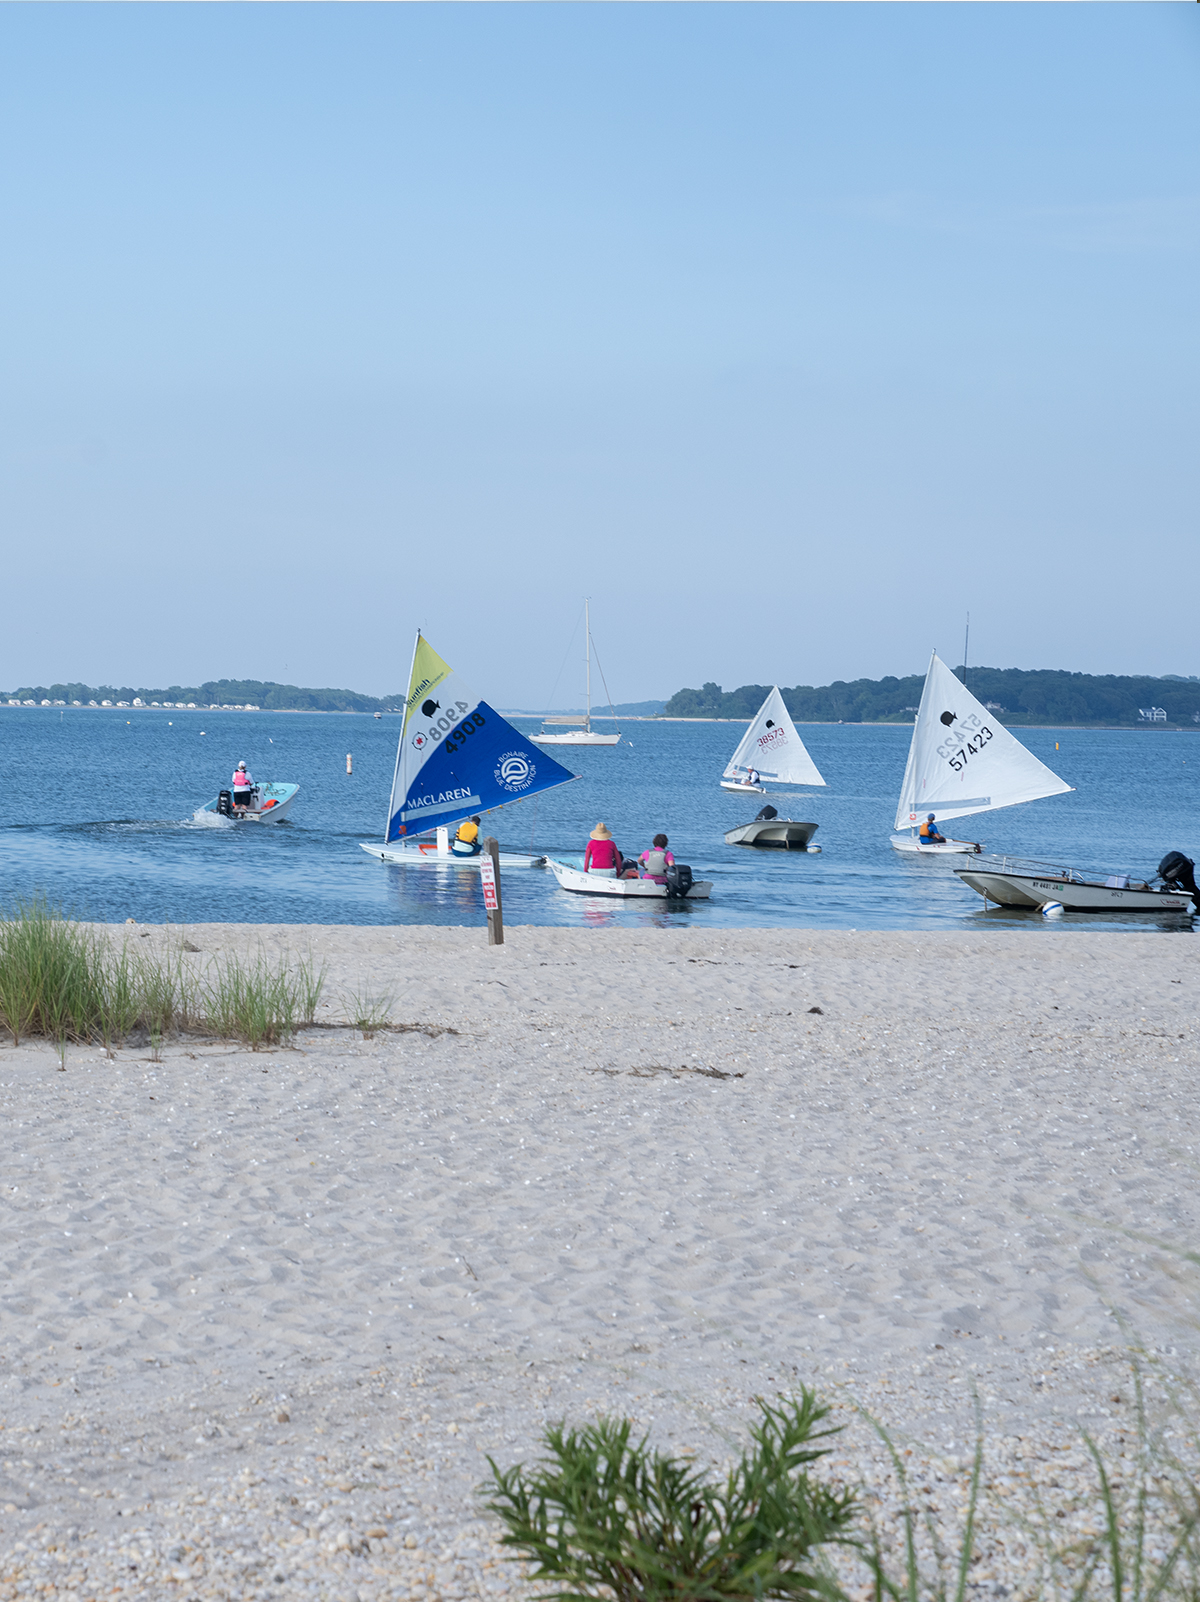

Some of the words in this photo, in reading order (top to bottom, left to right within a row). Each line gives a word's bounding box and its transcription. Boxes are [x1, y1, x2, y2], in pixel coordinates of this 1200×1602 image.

[445, 713, 486, 754] 4908
[756, 727, 785, 747] 38573
[497, 751, 529, 763] BONAIRE
[948, 726, 994, 772] 57423
[493, 769, 506, 787] BLUE
[504, 764, 537, 793] DESTINATION
[407, 786, 472, 809] MACLAREN
